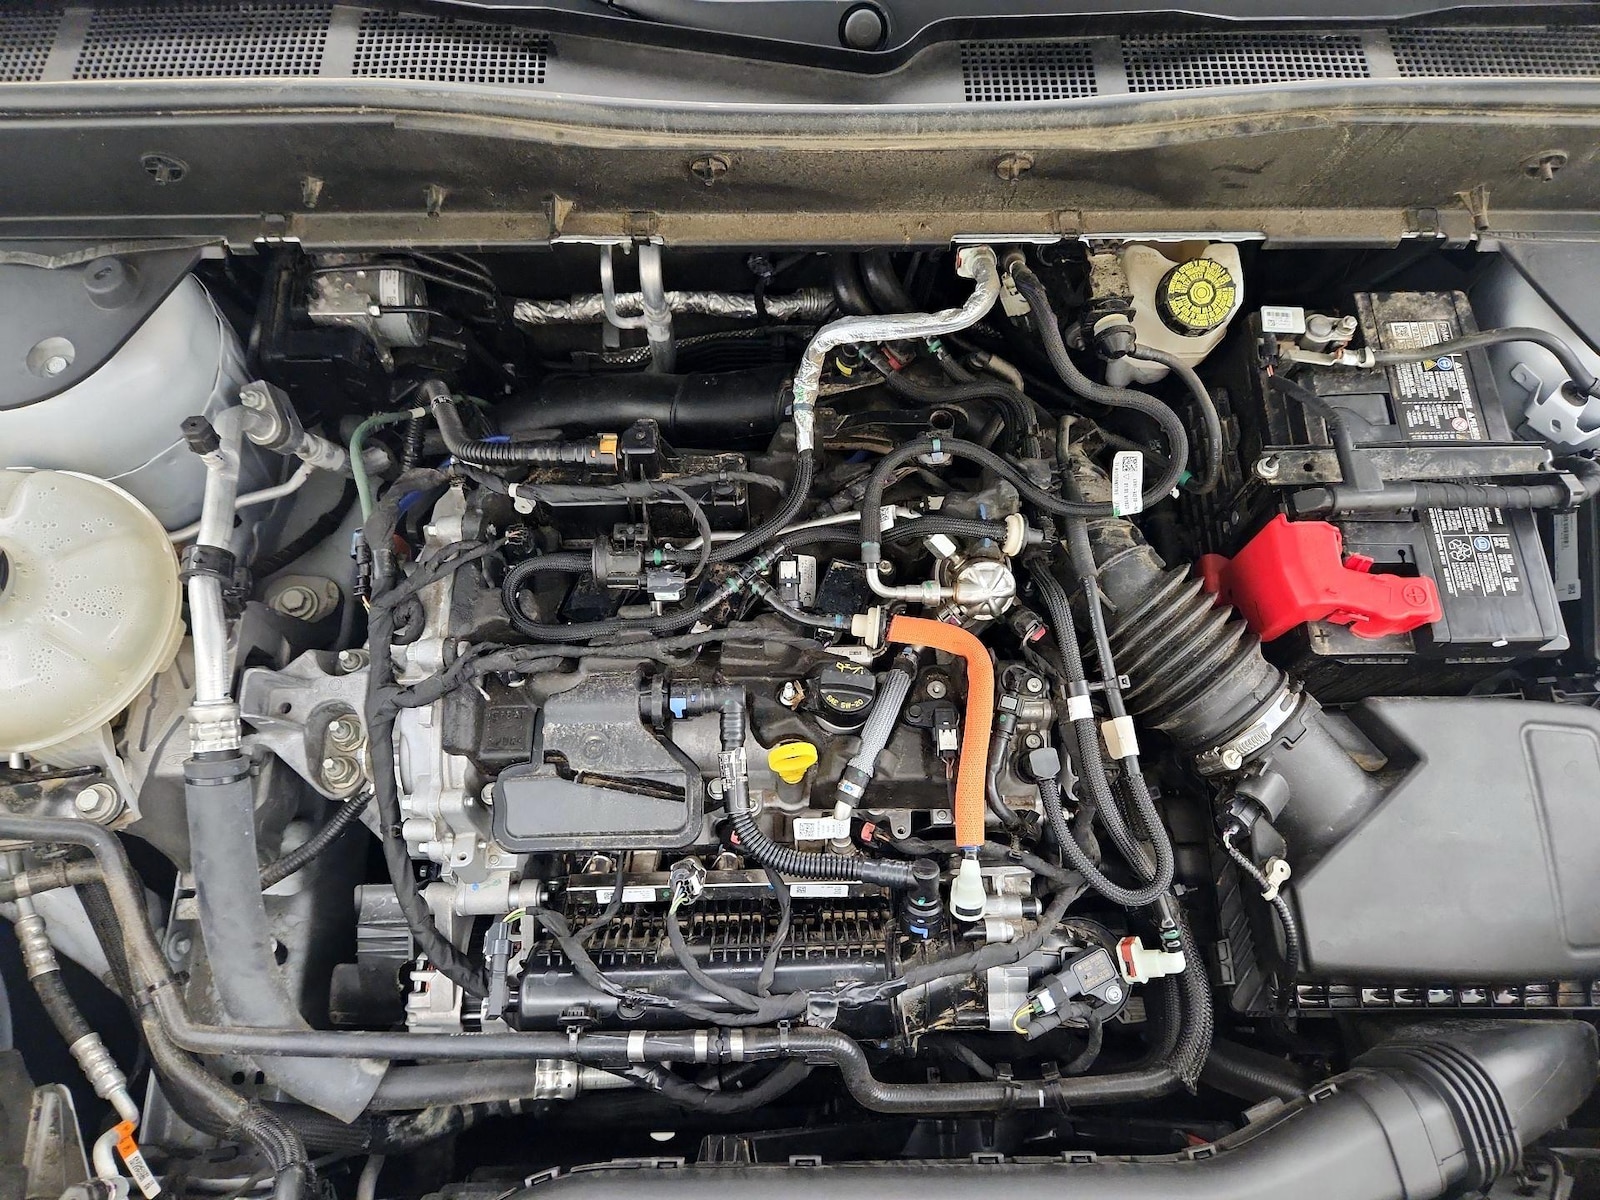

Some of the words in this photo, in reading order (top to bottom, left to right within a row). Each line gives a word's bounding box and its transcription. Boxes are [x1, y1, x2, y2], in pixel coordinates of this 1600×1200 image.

[1440, 323, 1449, 341] FoMo
[826, 694, 839, 706] SAE
[840, 698, 864, 710] 5W-20
